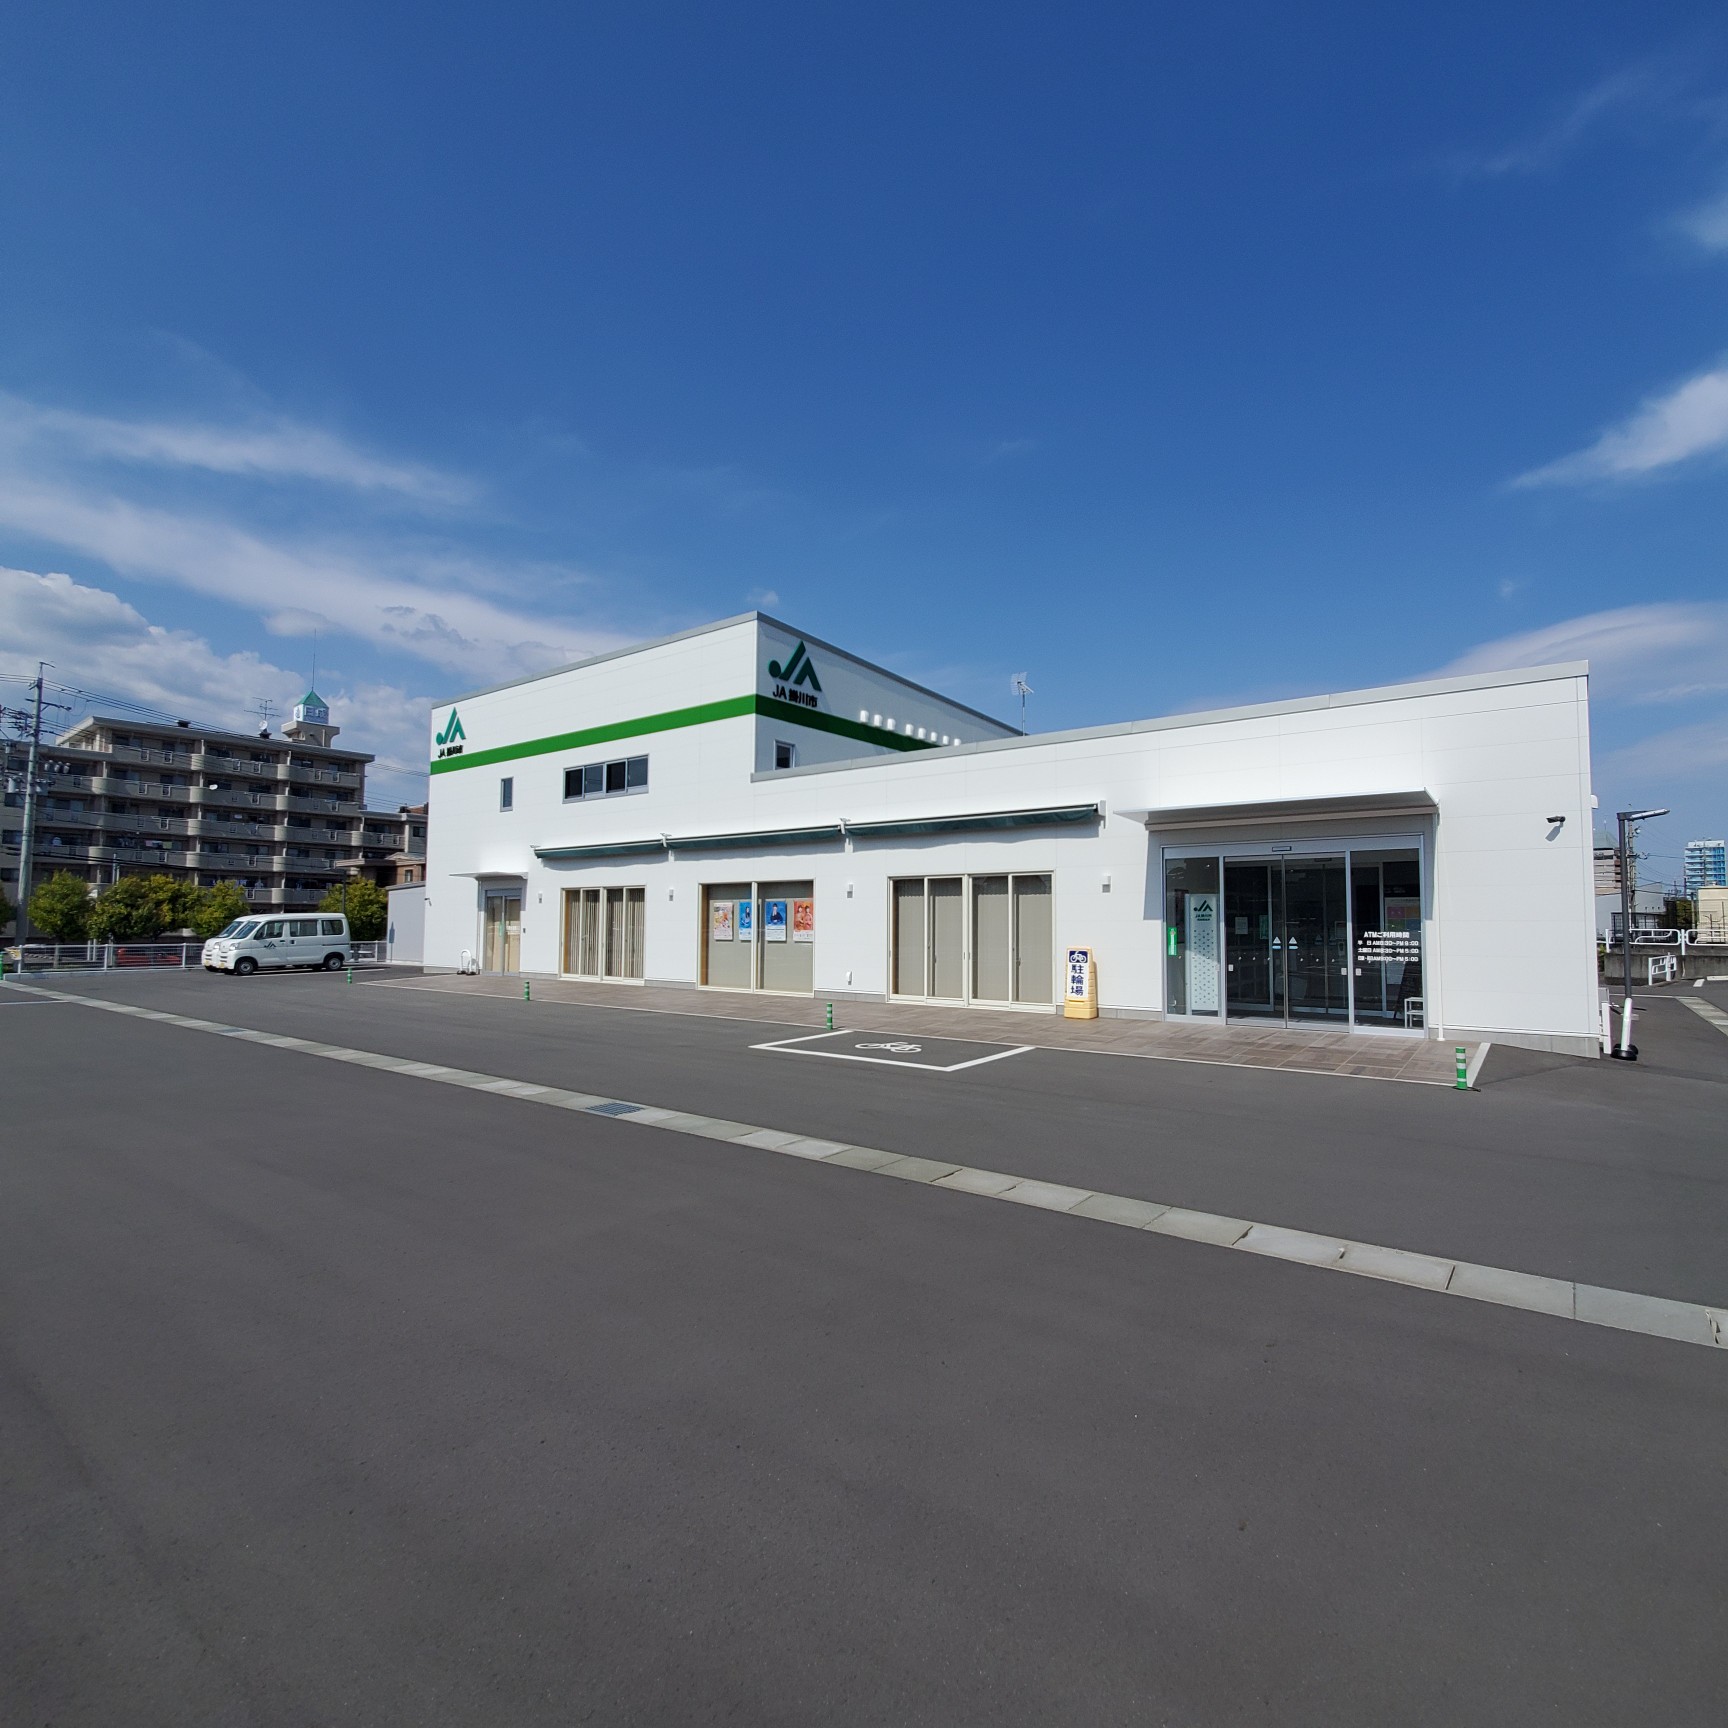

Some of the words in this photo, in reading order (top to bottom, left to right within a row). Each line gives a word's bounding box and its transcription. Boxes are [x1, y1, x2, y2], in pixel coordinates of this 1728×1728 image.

[772, 684, 787, 700] JA
[1070, 964, 1084, 996] 駐輪場
